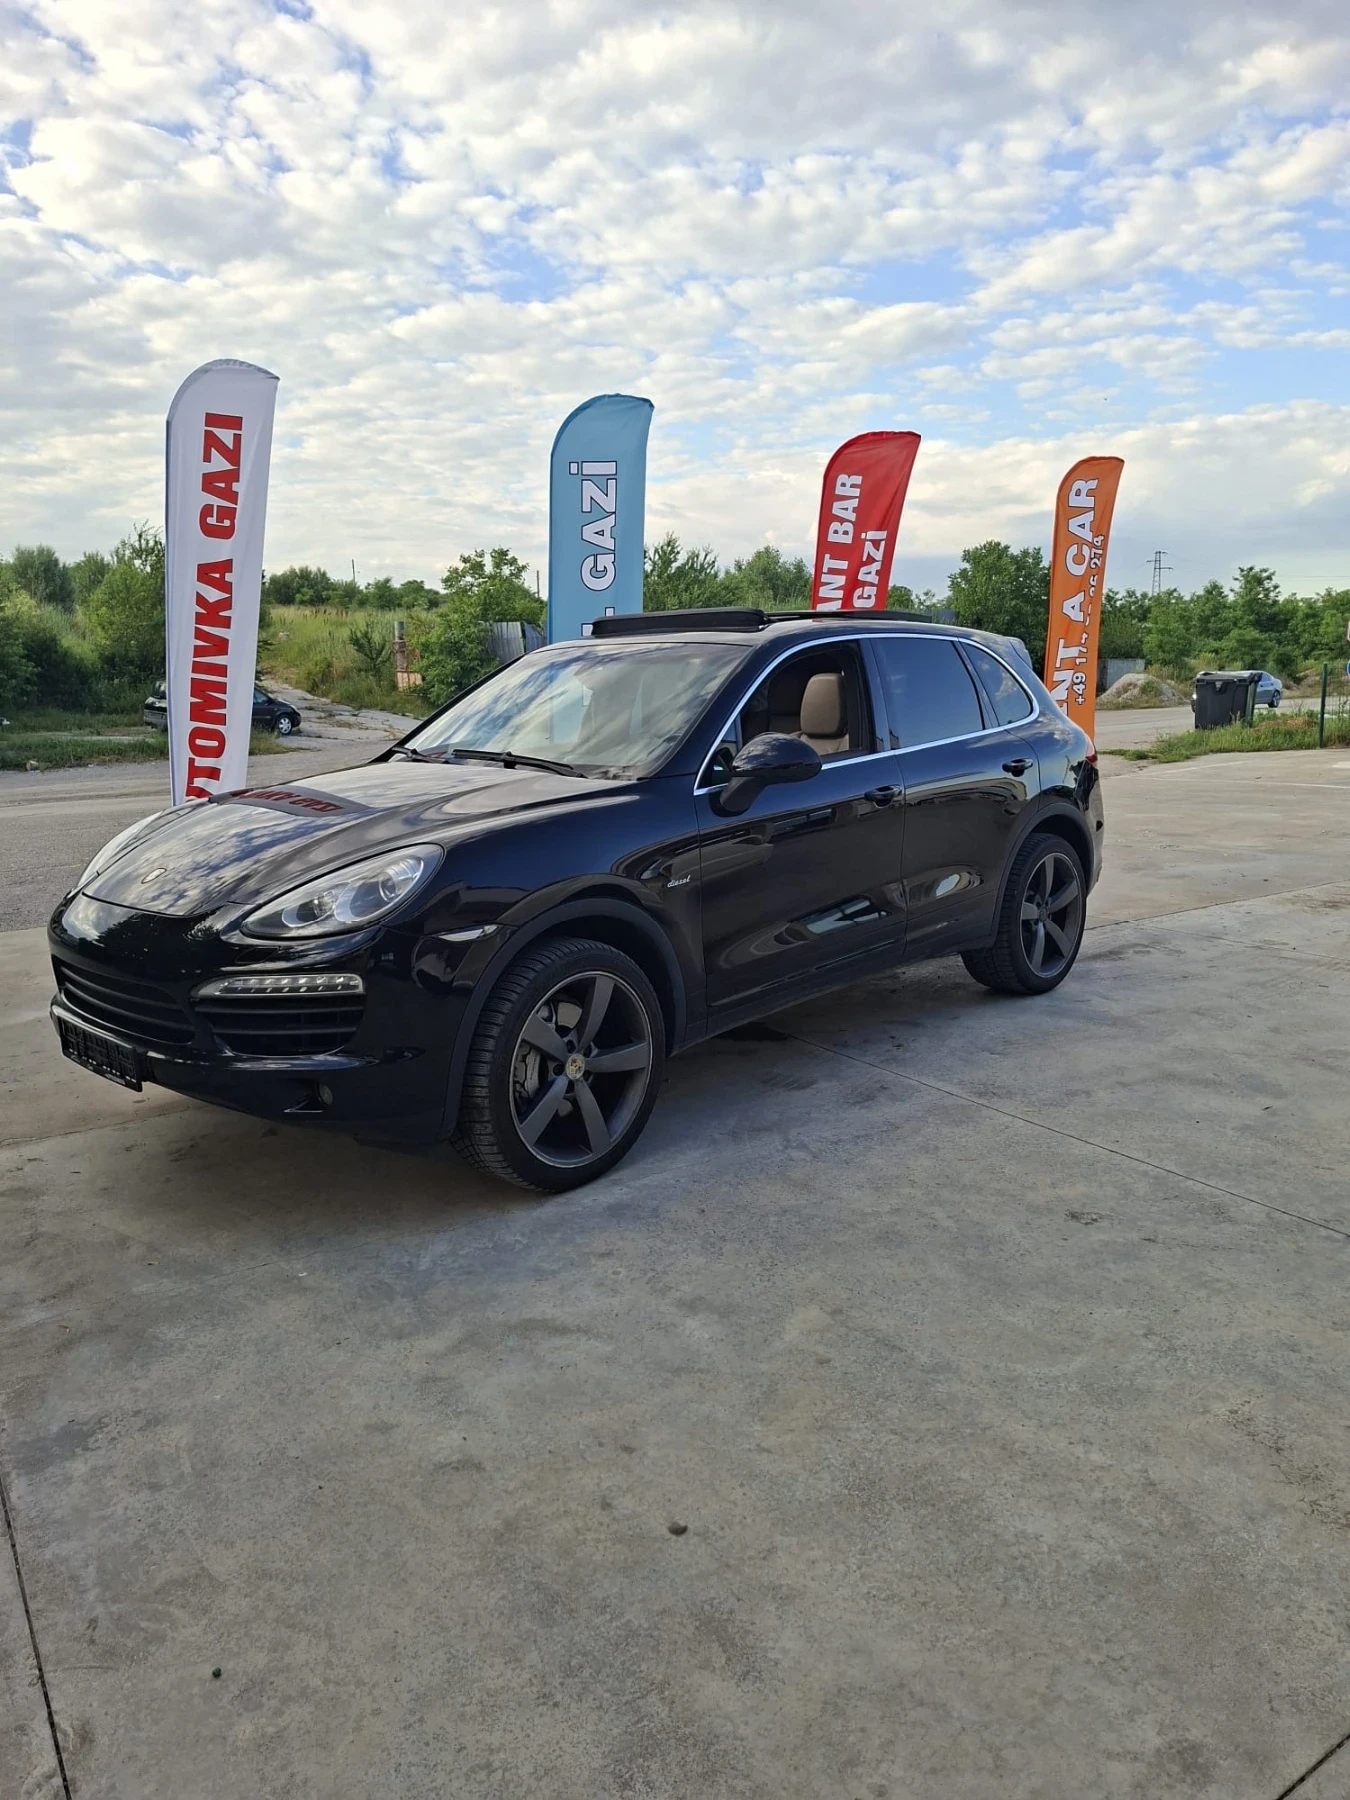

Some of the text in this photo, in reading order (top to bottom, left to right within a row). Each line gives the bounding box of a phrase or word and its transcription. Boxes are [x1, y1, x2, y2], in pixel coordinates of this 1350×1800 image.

[200, 412, 244, 540] GAZI
[827, 473, 863, 544] BAR
[1065, 478, 1100, 577] CAR
[1061, 590, 1086, 622] A
[1072, 671, 1087, 705] +49
[1089, 533, 1105, 570] 274
